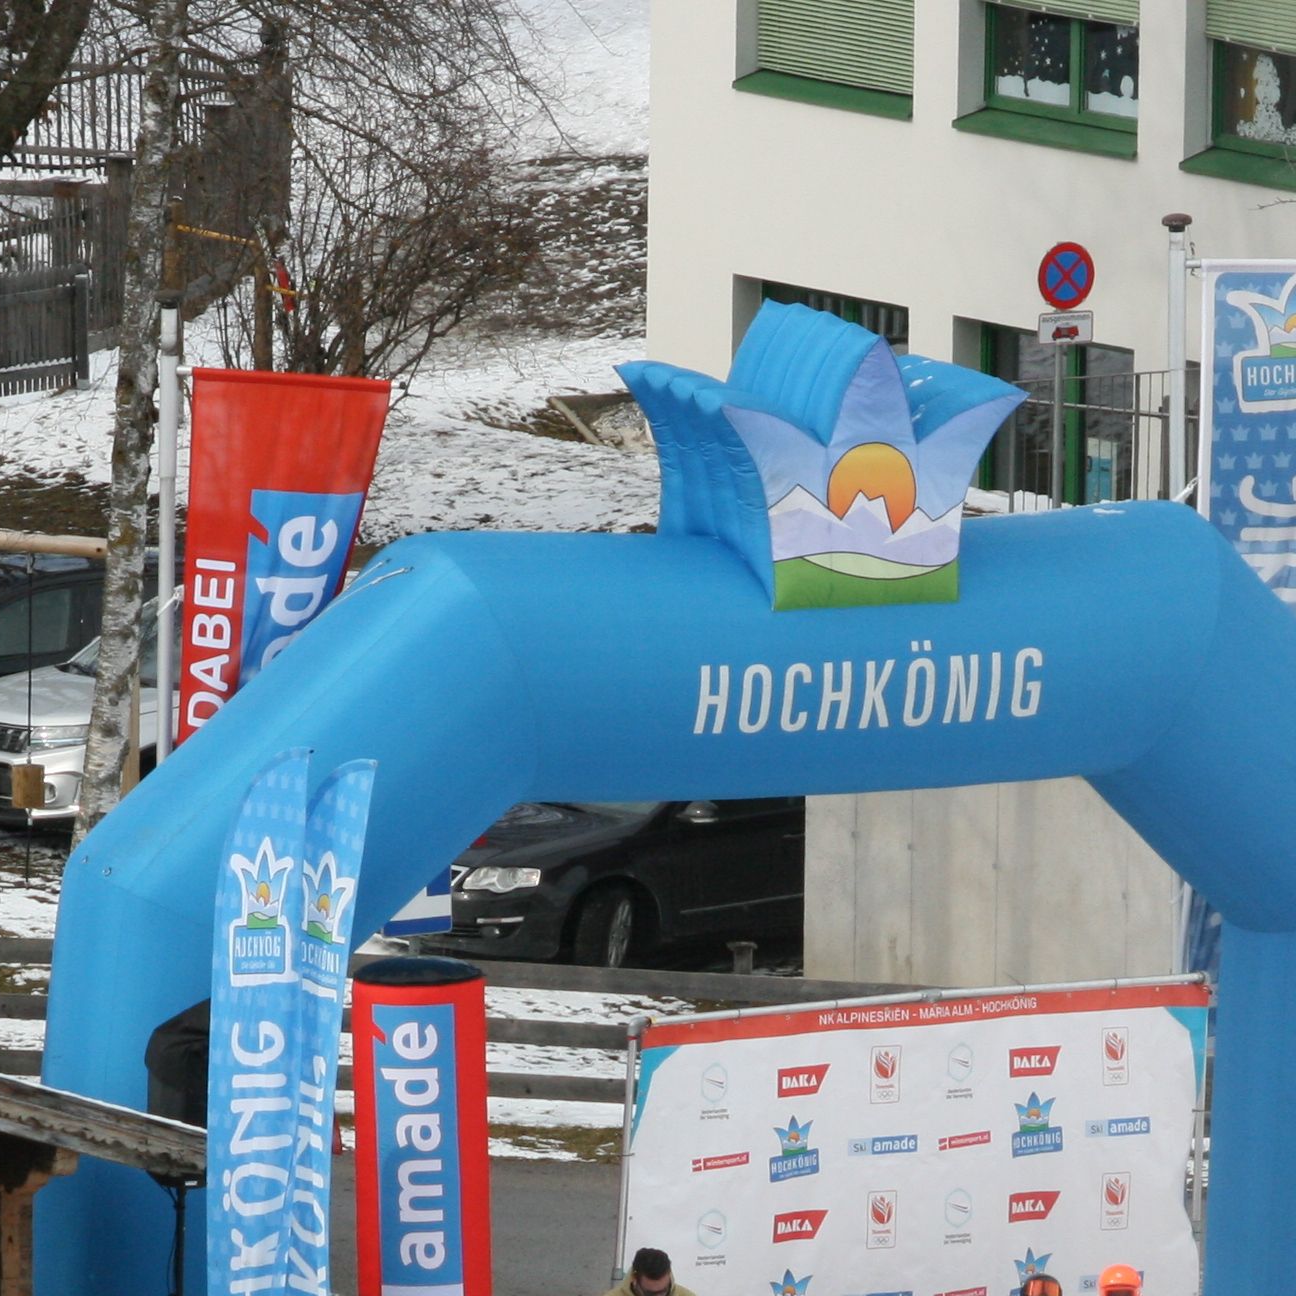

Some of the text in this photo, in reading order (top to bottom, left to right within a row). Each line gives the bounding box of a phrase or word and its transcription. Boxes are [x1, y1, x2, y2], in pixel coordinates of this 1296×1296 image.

[694, 641, 1043, 734] HOCHKÖNIG
[819, 1012, 835, 1026] NK
[919, 1004, 950, 1020] MARIA
[950, 1003, 973, 1017] ALM
[982, 996, 1037, 1015] HOCHKÖNIG
[1013, 1055, 1051, 1069] DAKA
[782, 1074, 818, 1090] DAKA
[1091, 1124, 1104, 1135] Ski
[853, 1143, 867, 1153] Ski
[1012, 1199, 1046, 1214] DAKA
[777, 1218, 814, 1235] DAKA
[1083, 1279, 1096, 1289] Ski
